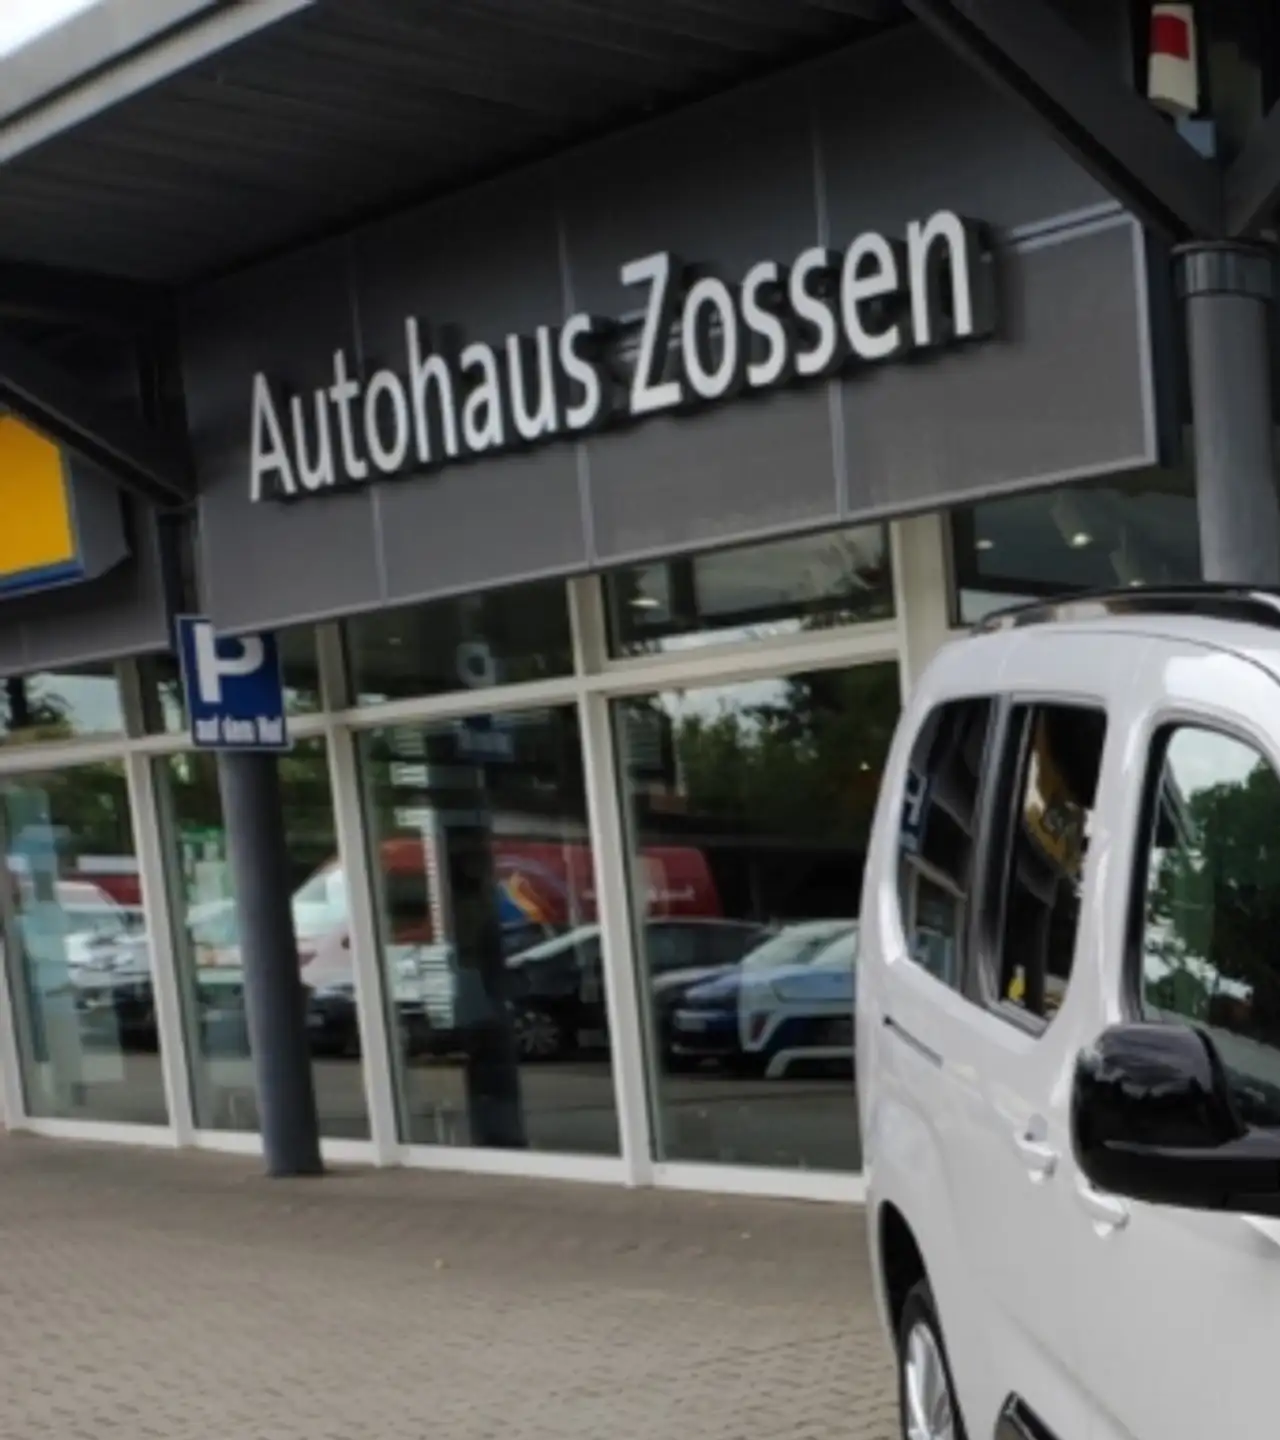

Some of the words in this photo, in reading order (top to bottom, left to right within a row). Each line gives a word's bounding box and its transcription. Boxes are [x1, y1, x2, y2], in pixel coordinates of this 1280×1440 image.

[249, 312, 599, 503] Autohaus
[620, 208, 978, 416] Zossen
[193, 621, 265, 704] P
